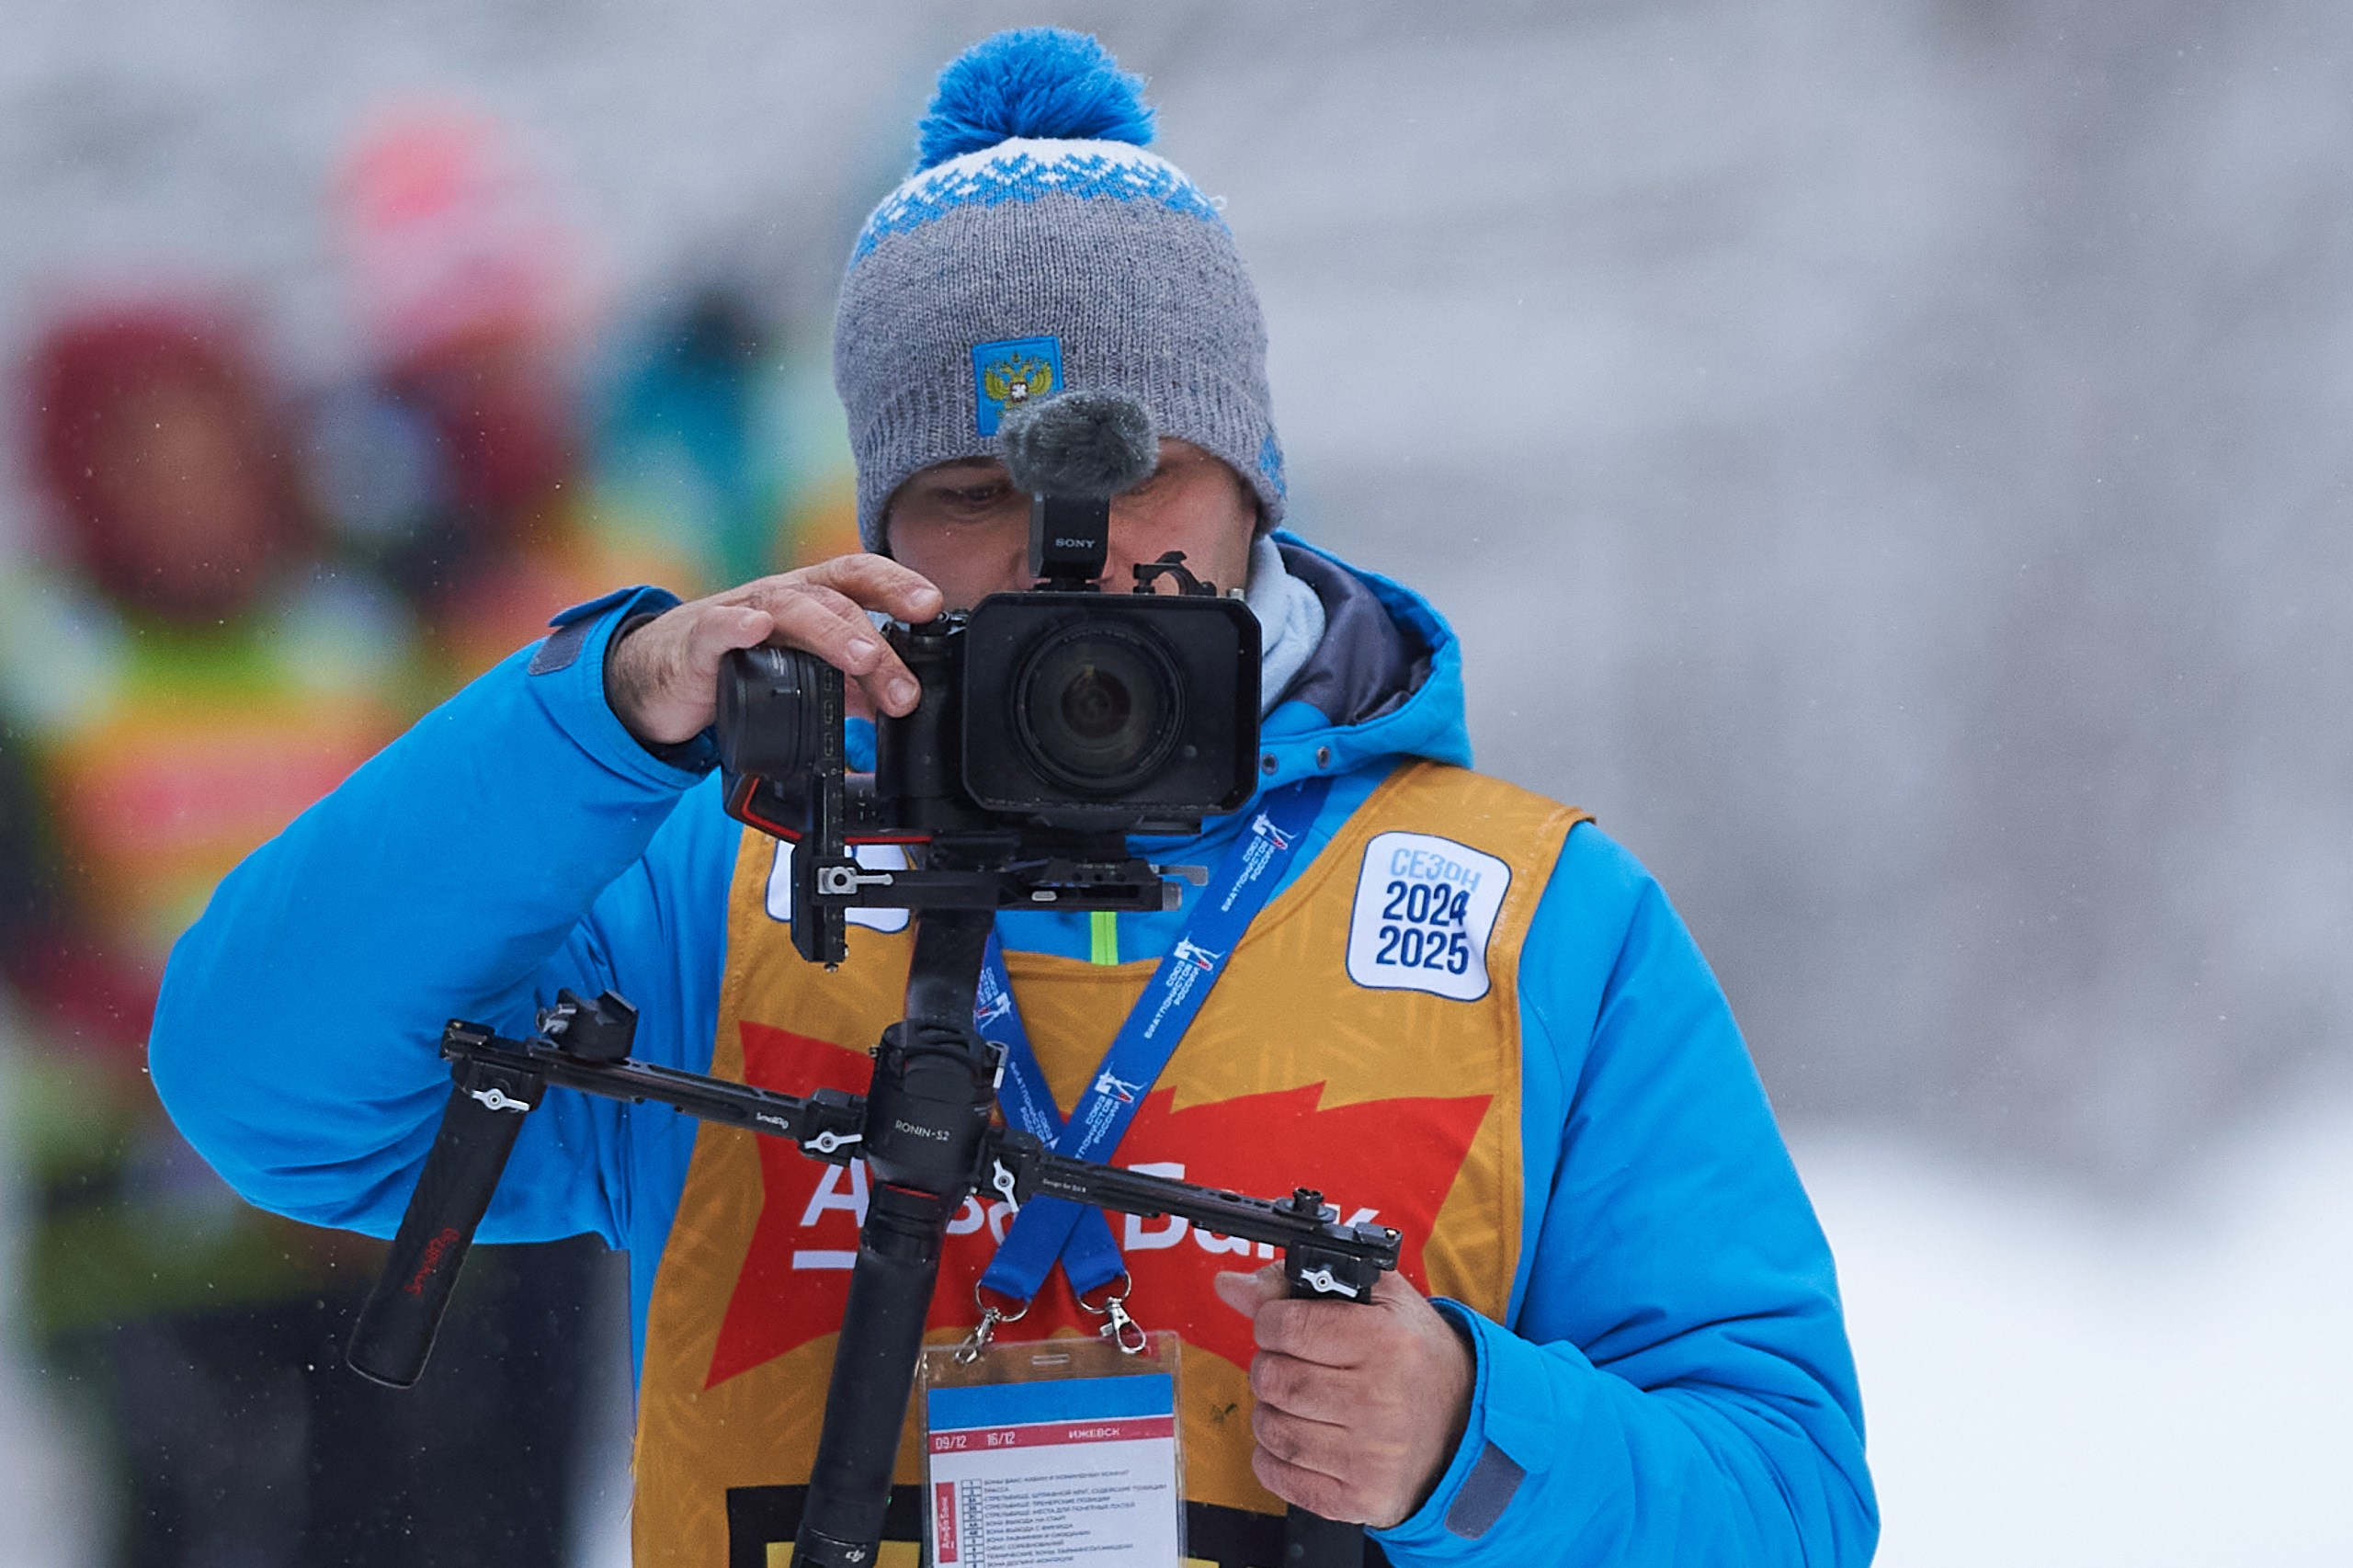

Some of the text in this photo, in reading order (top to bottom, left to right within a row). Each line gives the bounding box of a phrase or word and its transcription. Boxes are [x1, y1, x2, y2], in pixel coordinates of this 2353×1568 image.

[1055, 538, 1096, 549] SONY
[1390, 847, 1483, 892] СЕЗОН
[1382, 880, 1471, 927] 2024
[1376, 925, 1470, 975] 2025
[895, 1119, 950, 1142] RONIN-S2
[935, 1435, 967, 1450] 09/12
[986, 1431, 1016, 1447] 16/12
